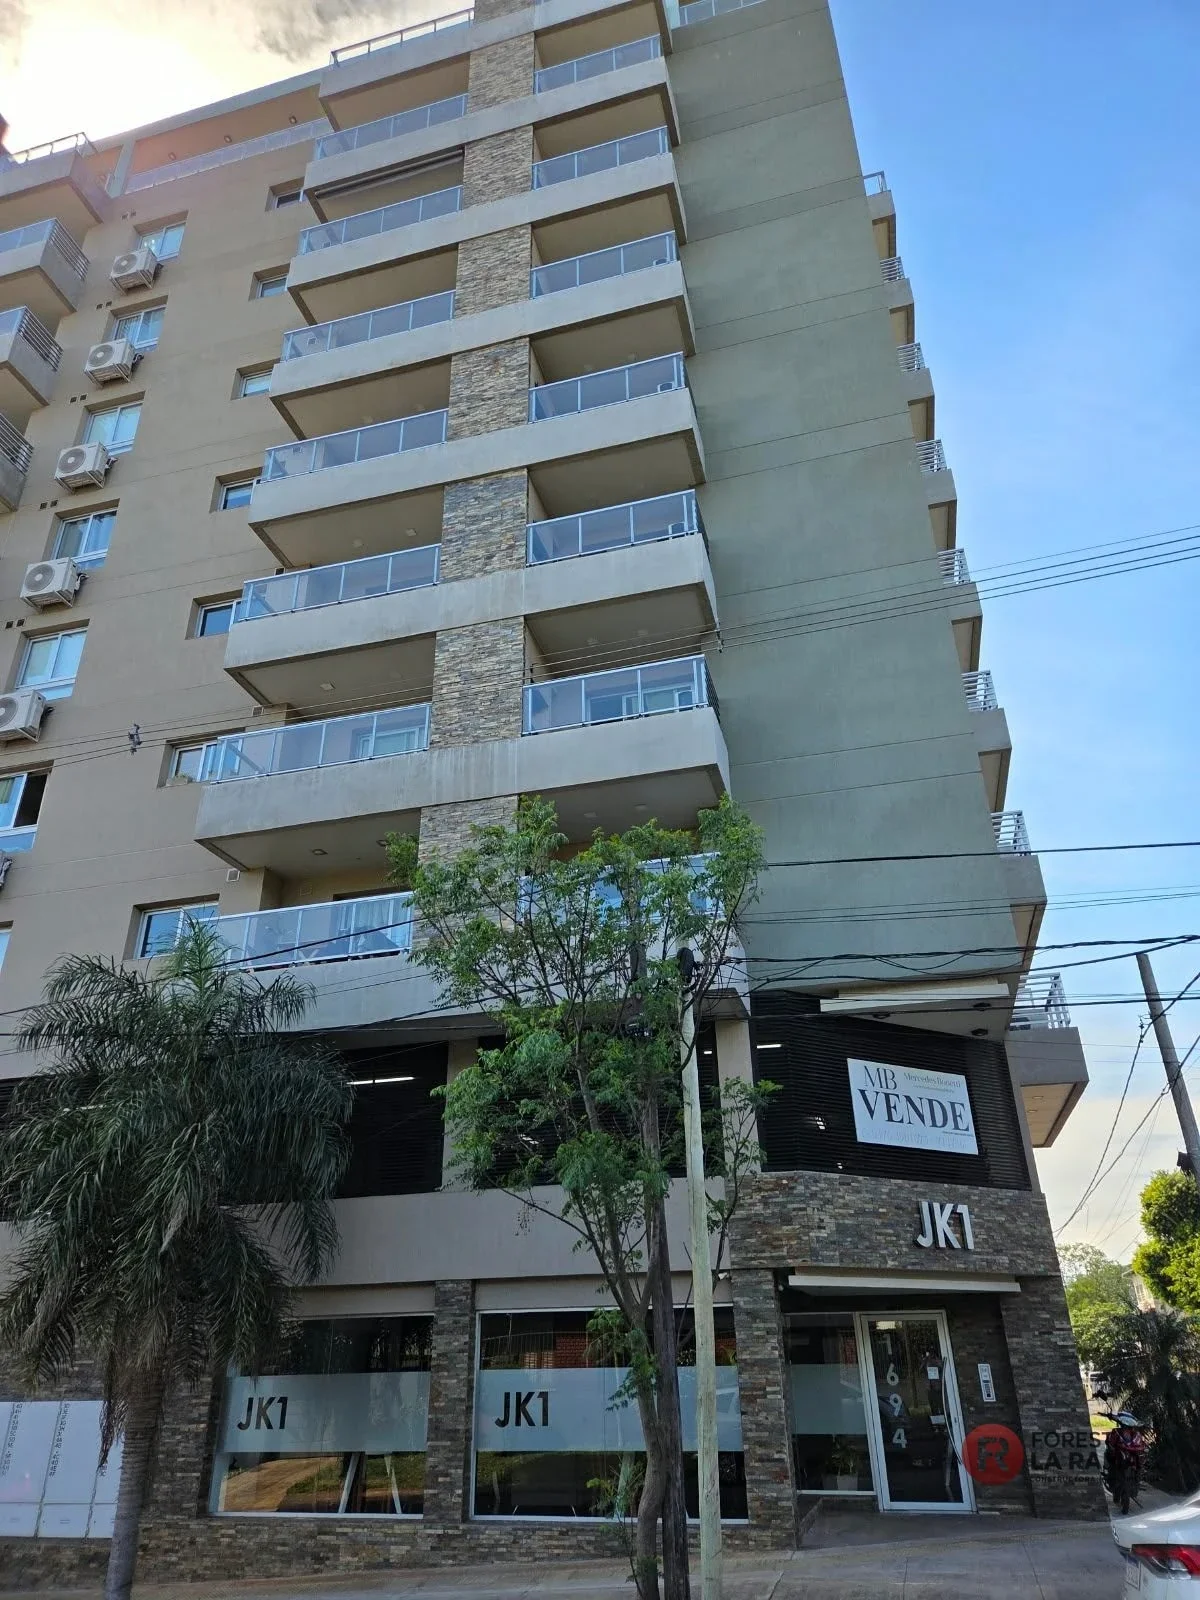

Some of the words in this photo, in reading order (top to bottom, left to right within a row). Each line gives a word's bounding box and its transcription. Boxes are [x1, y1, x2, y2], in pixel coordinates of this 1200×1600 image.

[863, 1065, 898, 1091] MB
[857, 1088, 970, 1132] VENDE
[916, 1200, 975, 1250] JK1
[237, 1396, 289, 1430] JK1
[495, 1391, 549, 1428] JK1
